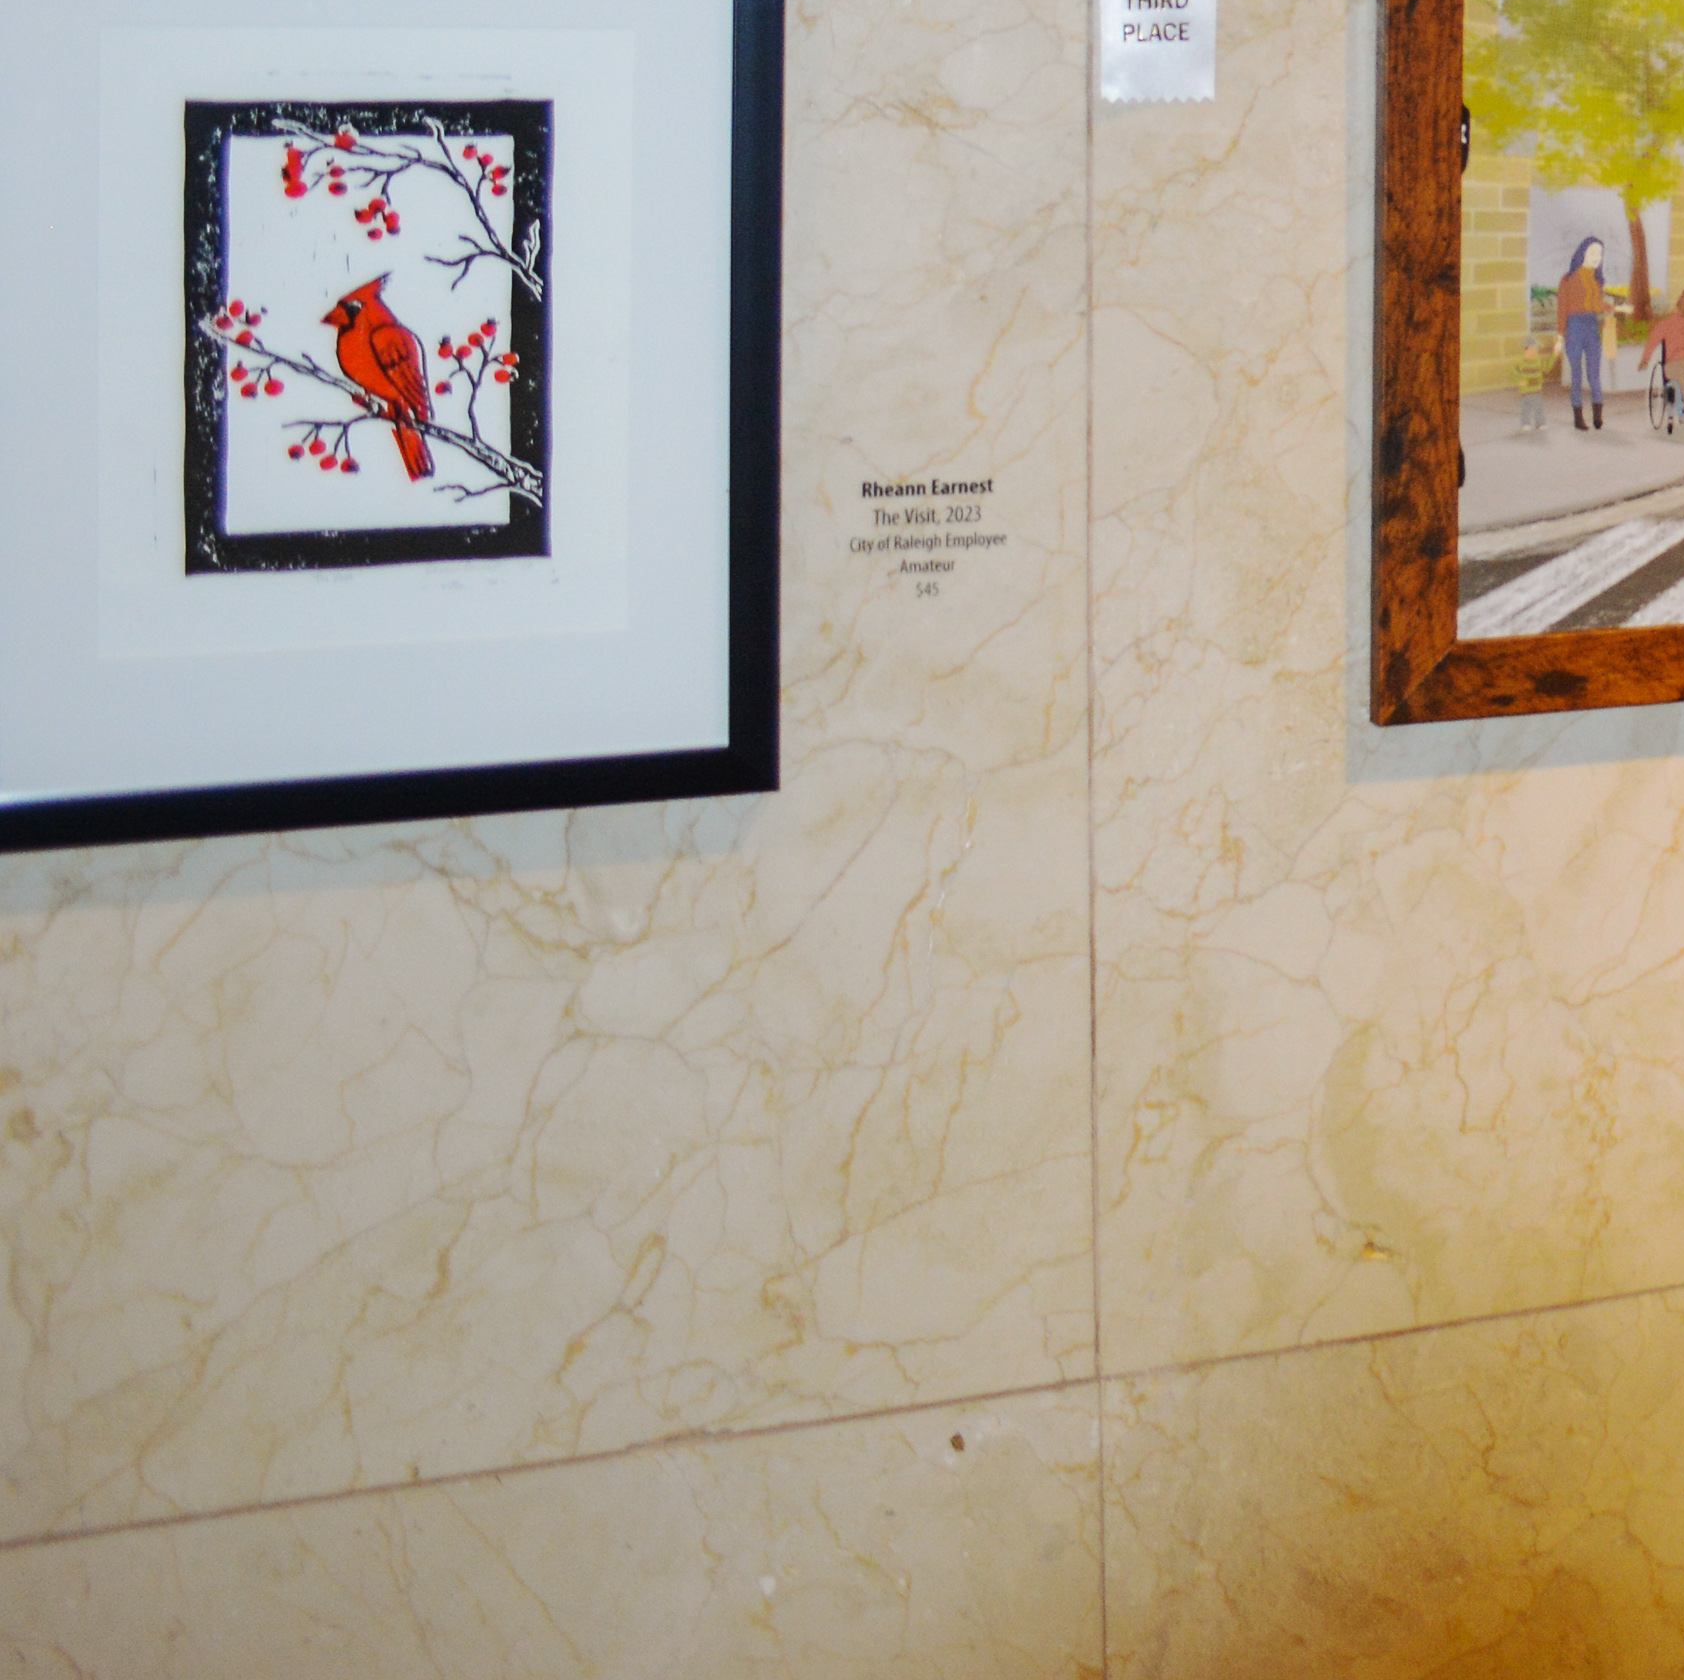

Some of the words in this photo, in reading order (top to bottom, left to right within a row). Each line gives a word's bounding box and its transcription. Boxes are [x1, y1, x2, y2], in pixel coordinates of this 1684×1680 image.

[1122, 22, 1190, 42] PLACE
[862, 480, 926, 499] Rheann
[931, 477, 994, 496] Earnest
[873, 508, 900, 526] The
[904, 506, 941, 525] Visit,
[945, 505, 982, 524] 2023
[850, 537, 874, 555] City
[877, 537, 891, 551] of
[894, 534, 942, 553] Raleigh
[945, 531, 1007, 550] Employee
[900, 559, 955, 574] Amateur
